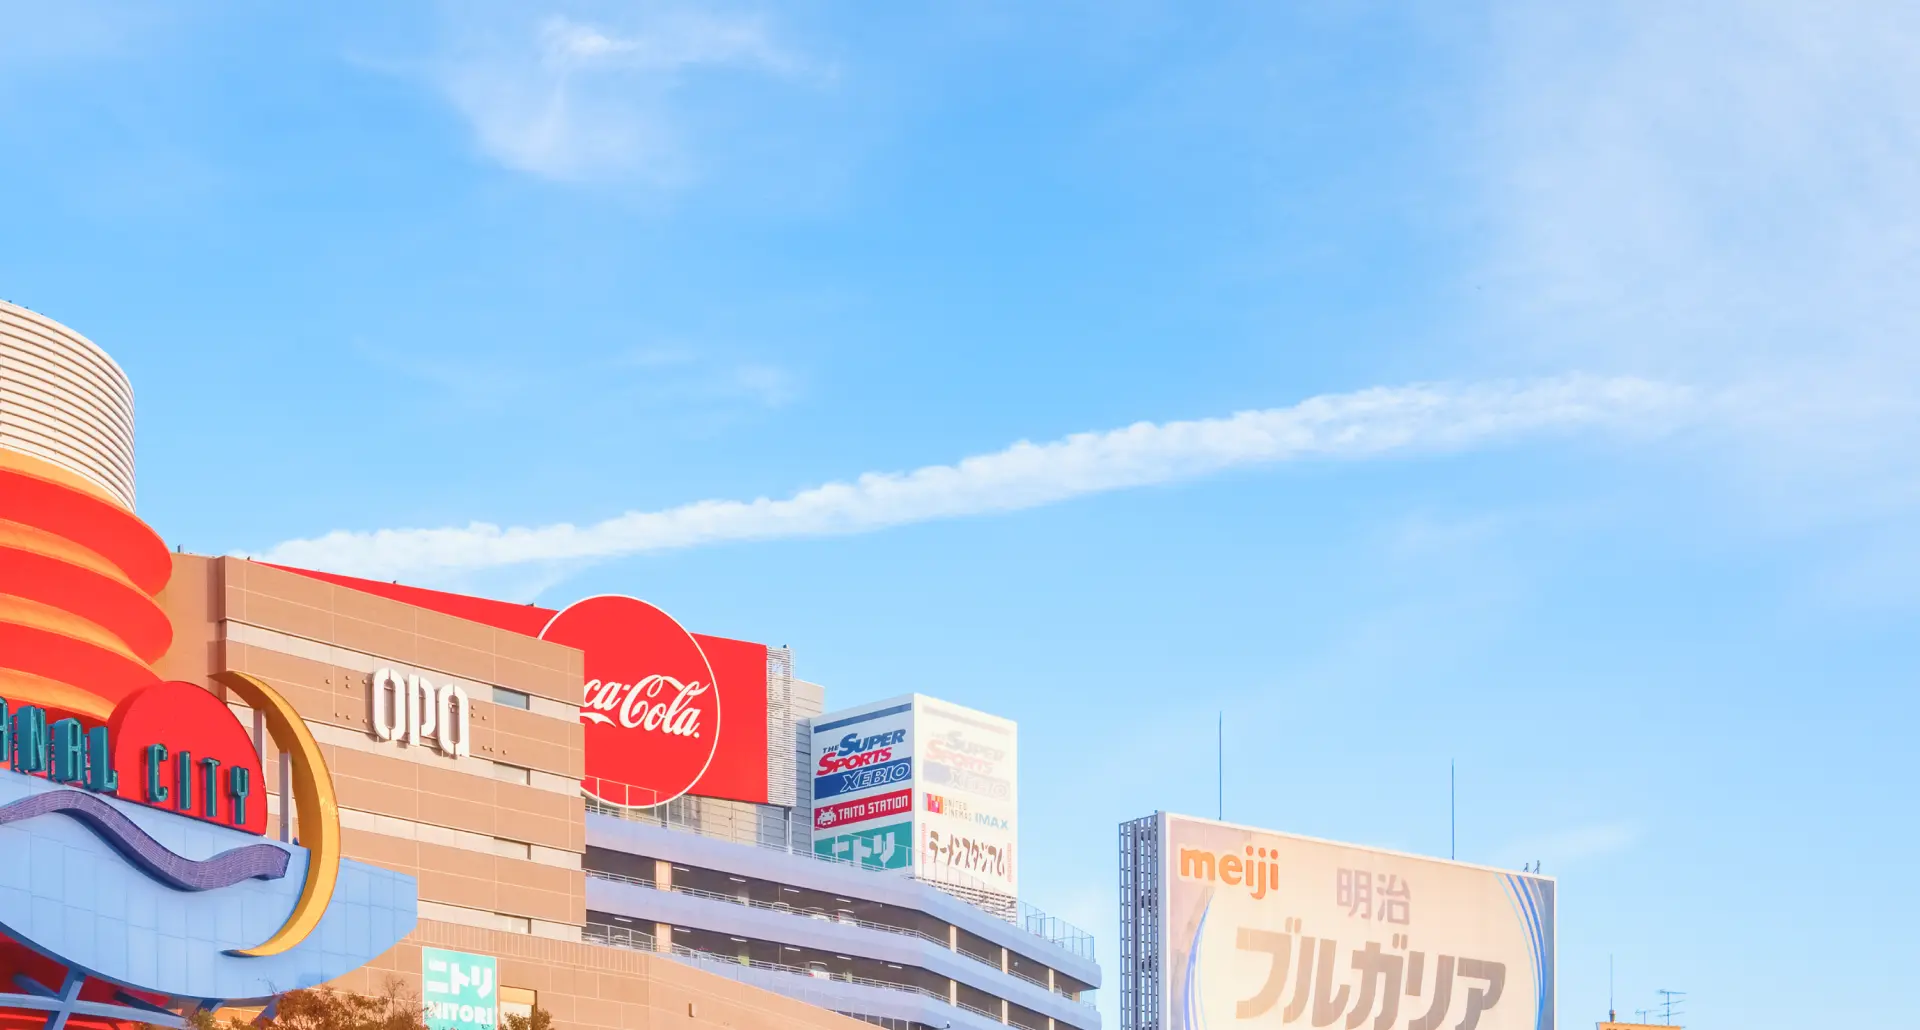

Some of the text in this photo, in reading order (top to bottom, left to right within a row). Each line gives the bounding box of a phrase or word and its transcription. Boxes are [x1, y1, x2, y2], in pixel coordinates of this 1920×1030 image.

[373, 668, 470, 758] OPA
[823, 729, 906, 756] THE SUPER
[816, 747, 892, 776] SPORTS
[840, 762, 910, 793] XEBIO
[147, 743, 249, 825] CITY
[838, 795, 908, 820] TAITO STATION
[944, 798, 967, 811] UNITED
[944, 807, 1009, 830] CINEMAS IMAX
[929, 831, 1005, 877] ラーメンスタジアム
[1180, 846, 1279, 900] meiji
[1336, 867, 1411, 926] 明治
[427, 959, 493, 999] ニトリ
[1236, 916, 1507, 1030] ブルガリア
[427, 1000, 493, 1025] NITORI
